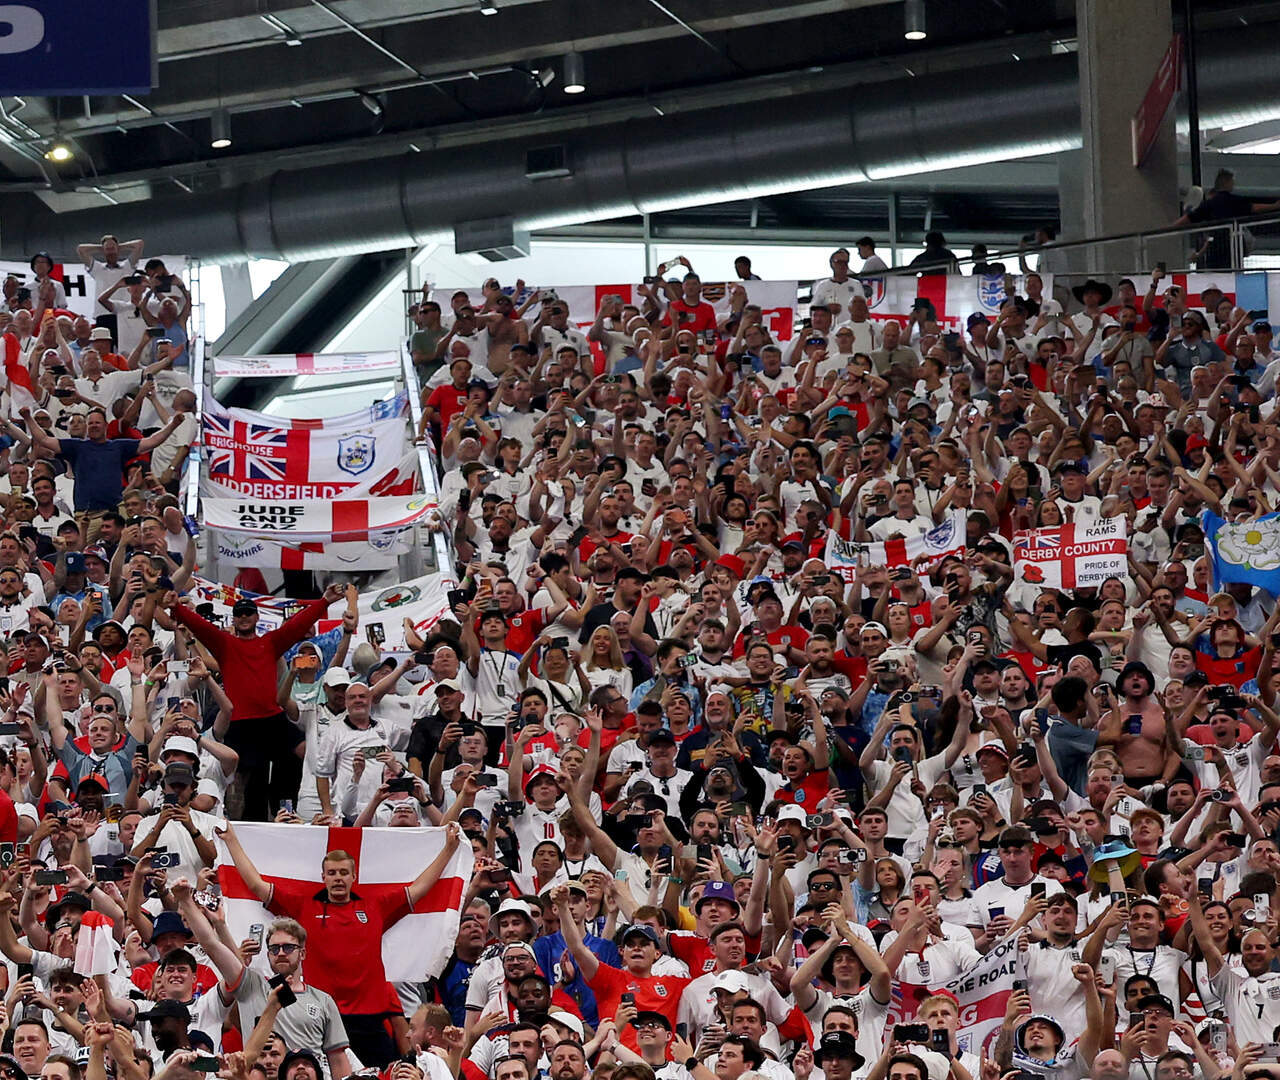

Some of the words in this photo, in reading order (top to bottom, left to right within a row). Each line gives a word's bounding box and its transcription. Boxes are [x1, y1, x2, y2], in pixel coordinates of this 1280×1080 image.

[210, 436, 274, 457] BRIGHOUSE
[233, 505, 304, 516] JUDE
[239, 515, 297, 524] AND
[1085, 525, 1117, 537] RAMS
[218, 543, 264, 559] ORKSHIRE
[1021, 547, 1061, 560] DERBY
[1064, 540, 1116, 556] COUNTY
[1084, 561, 1108, 570] PRIDE
[1109, 560, 1120, 569] OF
[543, 822, 555, 839] 10
[553, 962, 562, 983] 9
[978, 960, 1017, 987] ROAD
[1255, 1003, 1265, 1020] 7
